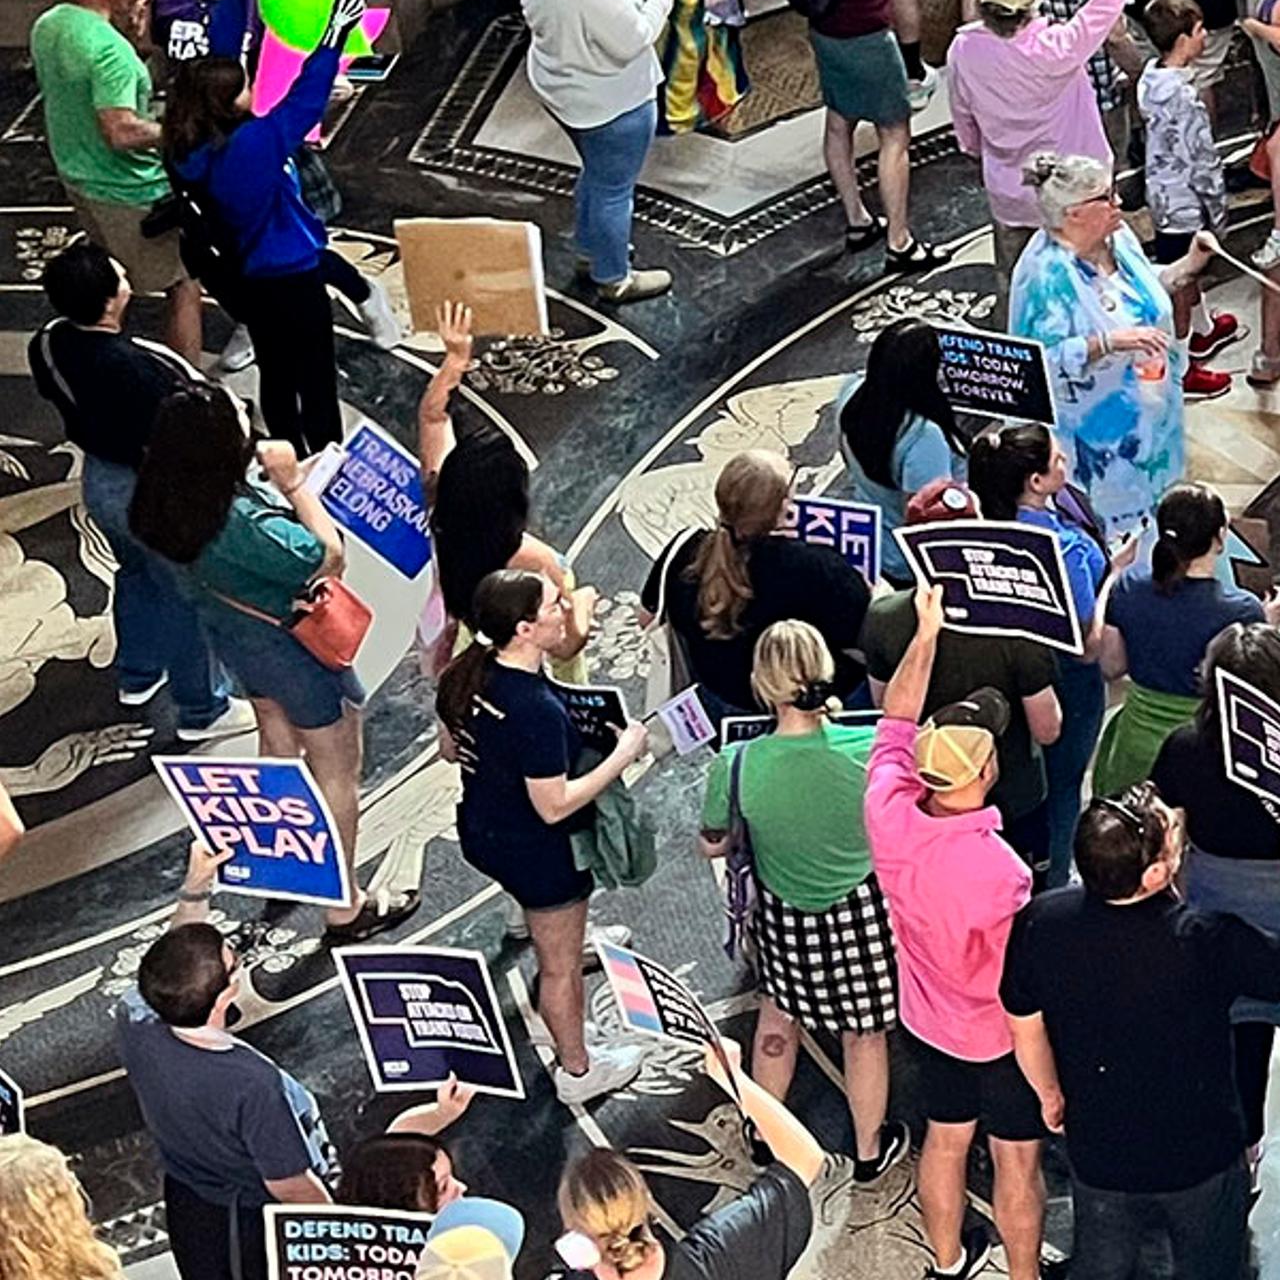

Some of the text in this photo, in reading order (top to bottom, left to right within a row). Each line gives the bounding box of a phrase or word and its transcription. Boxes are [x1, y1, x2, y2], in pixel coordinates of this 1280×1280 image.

[352, 434, 416, 489] TRANS
[329, 477, 393, 533] ELONG
[806, 505, 836, 547] KI
[169, 766, 260, 795] LET
[188, 795, 316, 828] KIDS
[206, 824, 329, 865] PLAY
[284, 1219, 426, 1246] DEFEND TRA
[286, 1242, 420, 1267] KIDS: TODA
